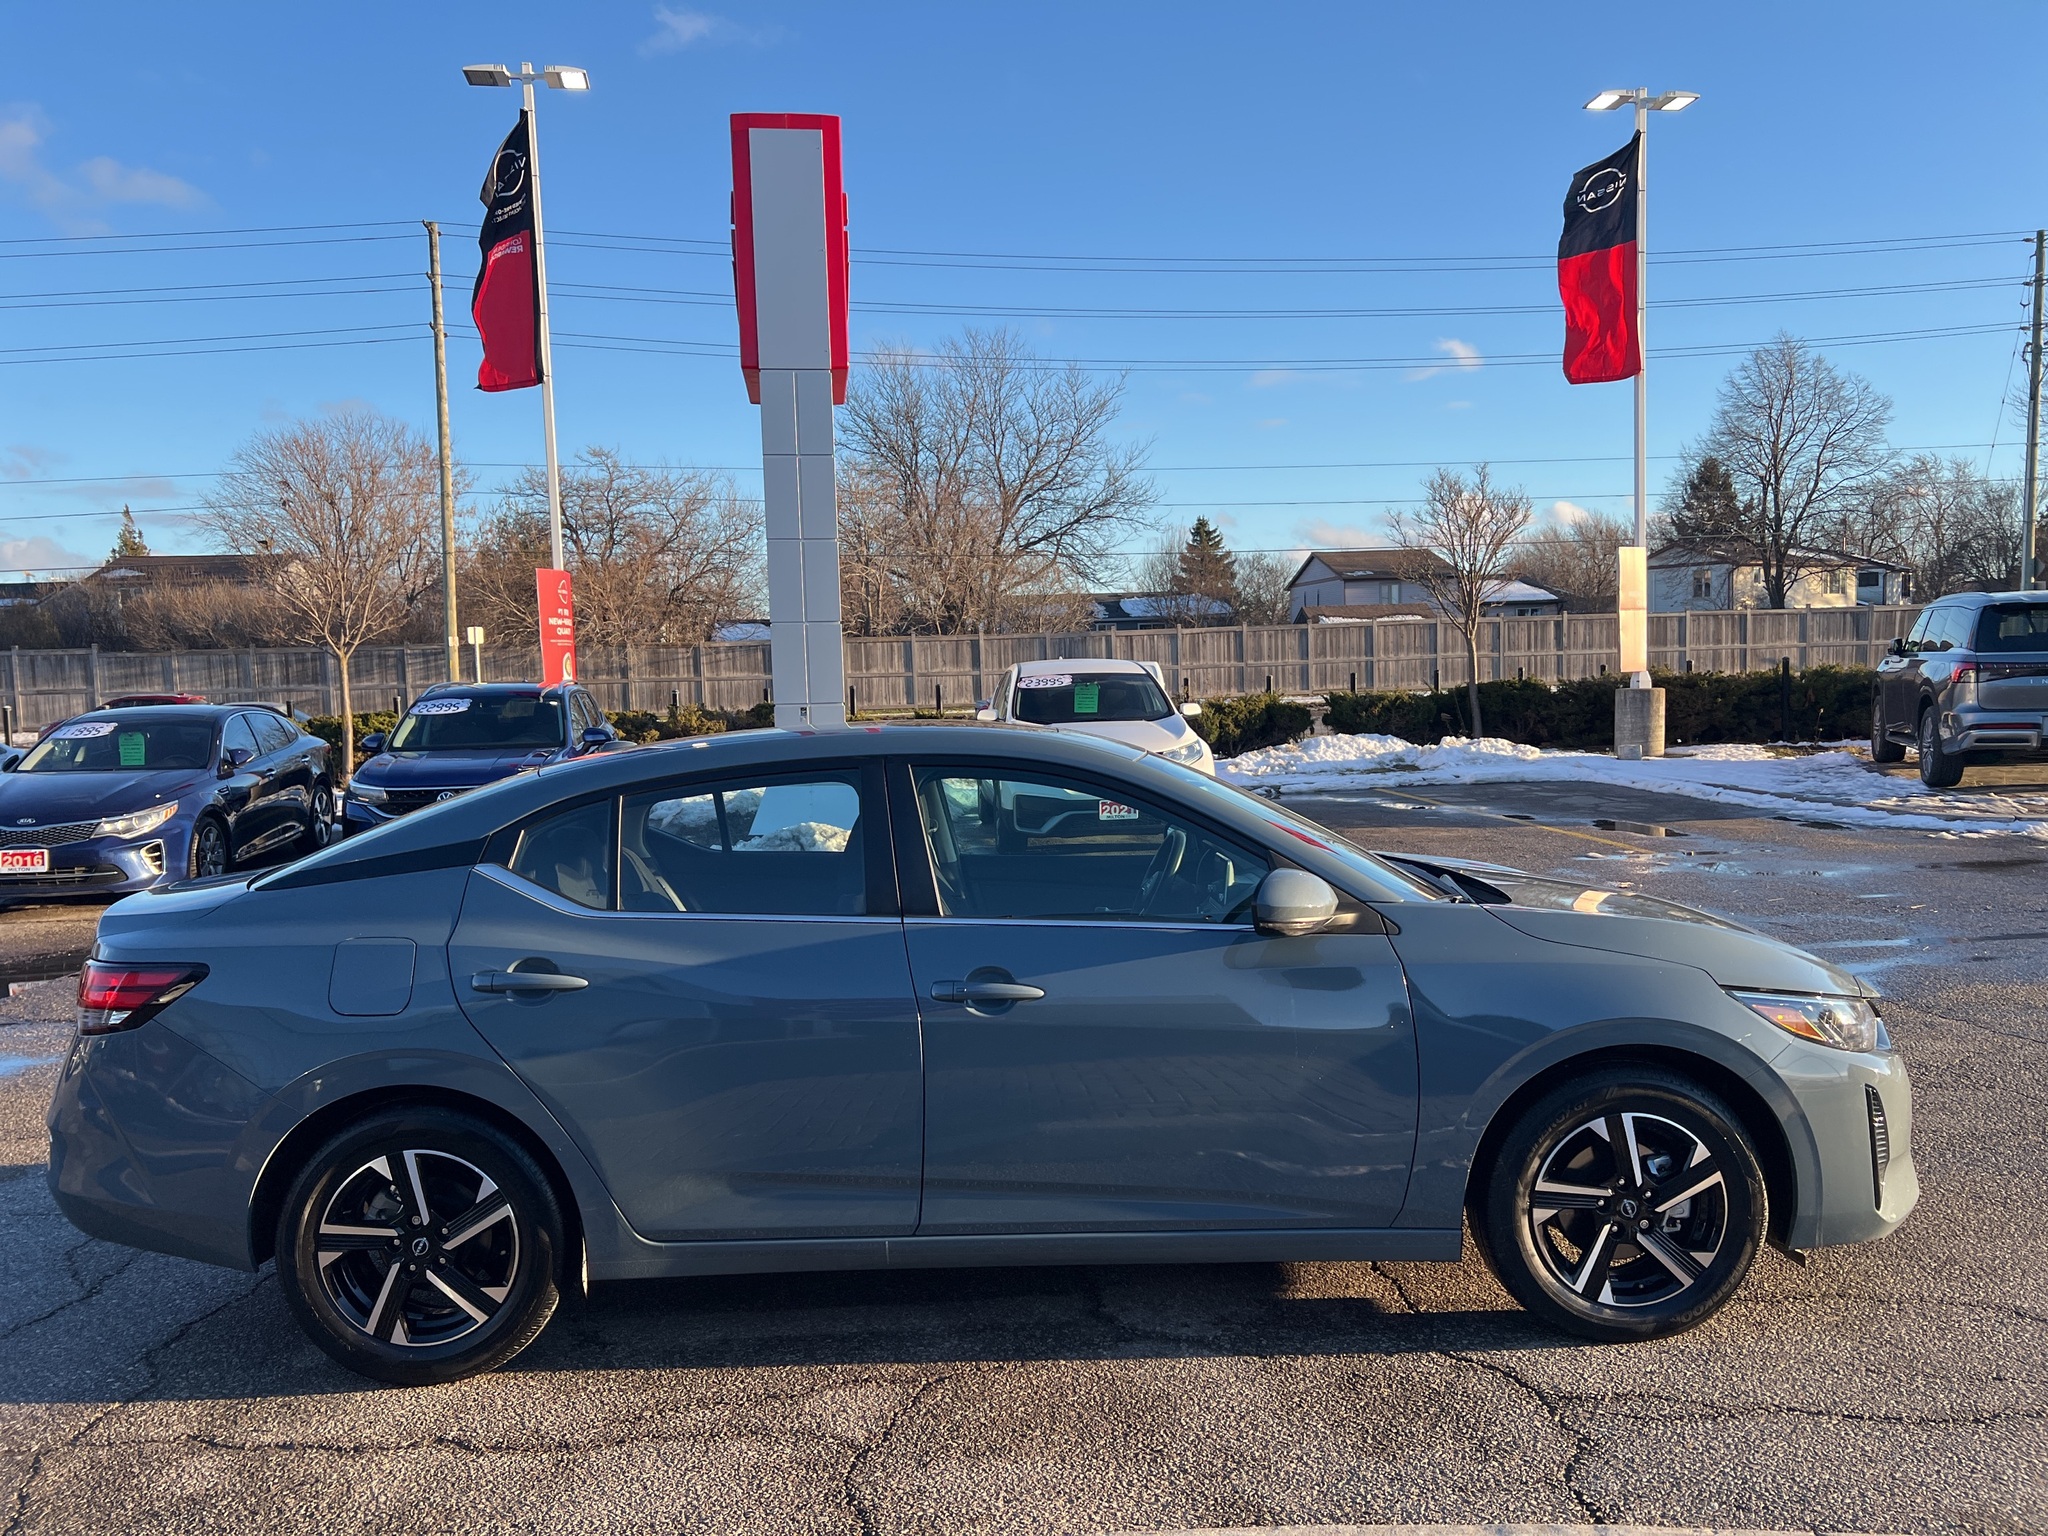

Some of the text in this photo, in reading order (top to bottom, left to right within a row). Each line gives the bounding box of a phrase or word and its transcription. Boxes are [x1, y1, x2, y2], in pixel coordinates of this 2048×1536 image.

[1025, 677, 1064, 688] 23995
[418, 702, 461, 713] 22995
[2, 855, 43, 868] 2016
